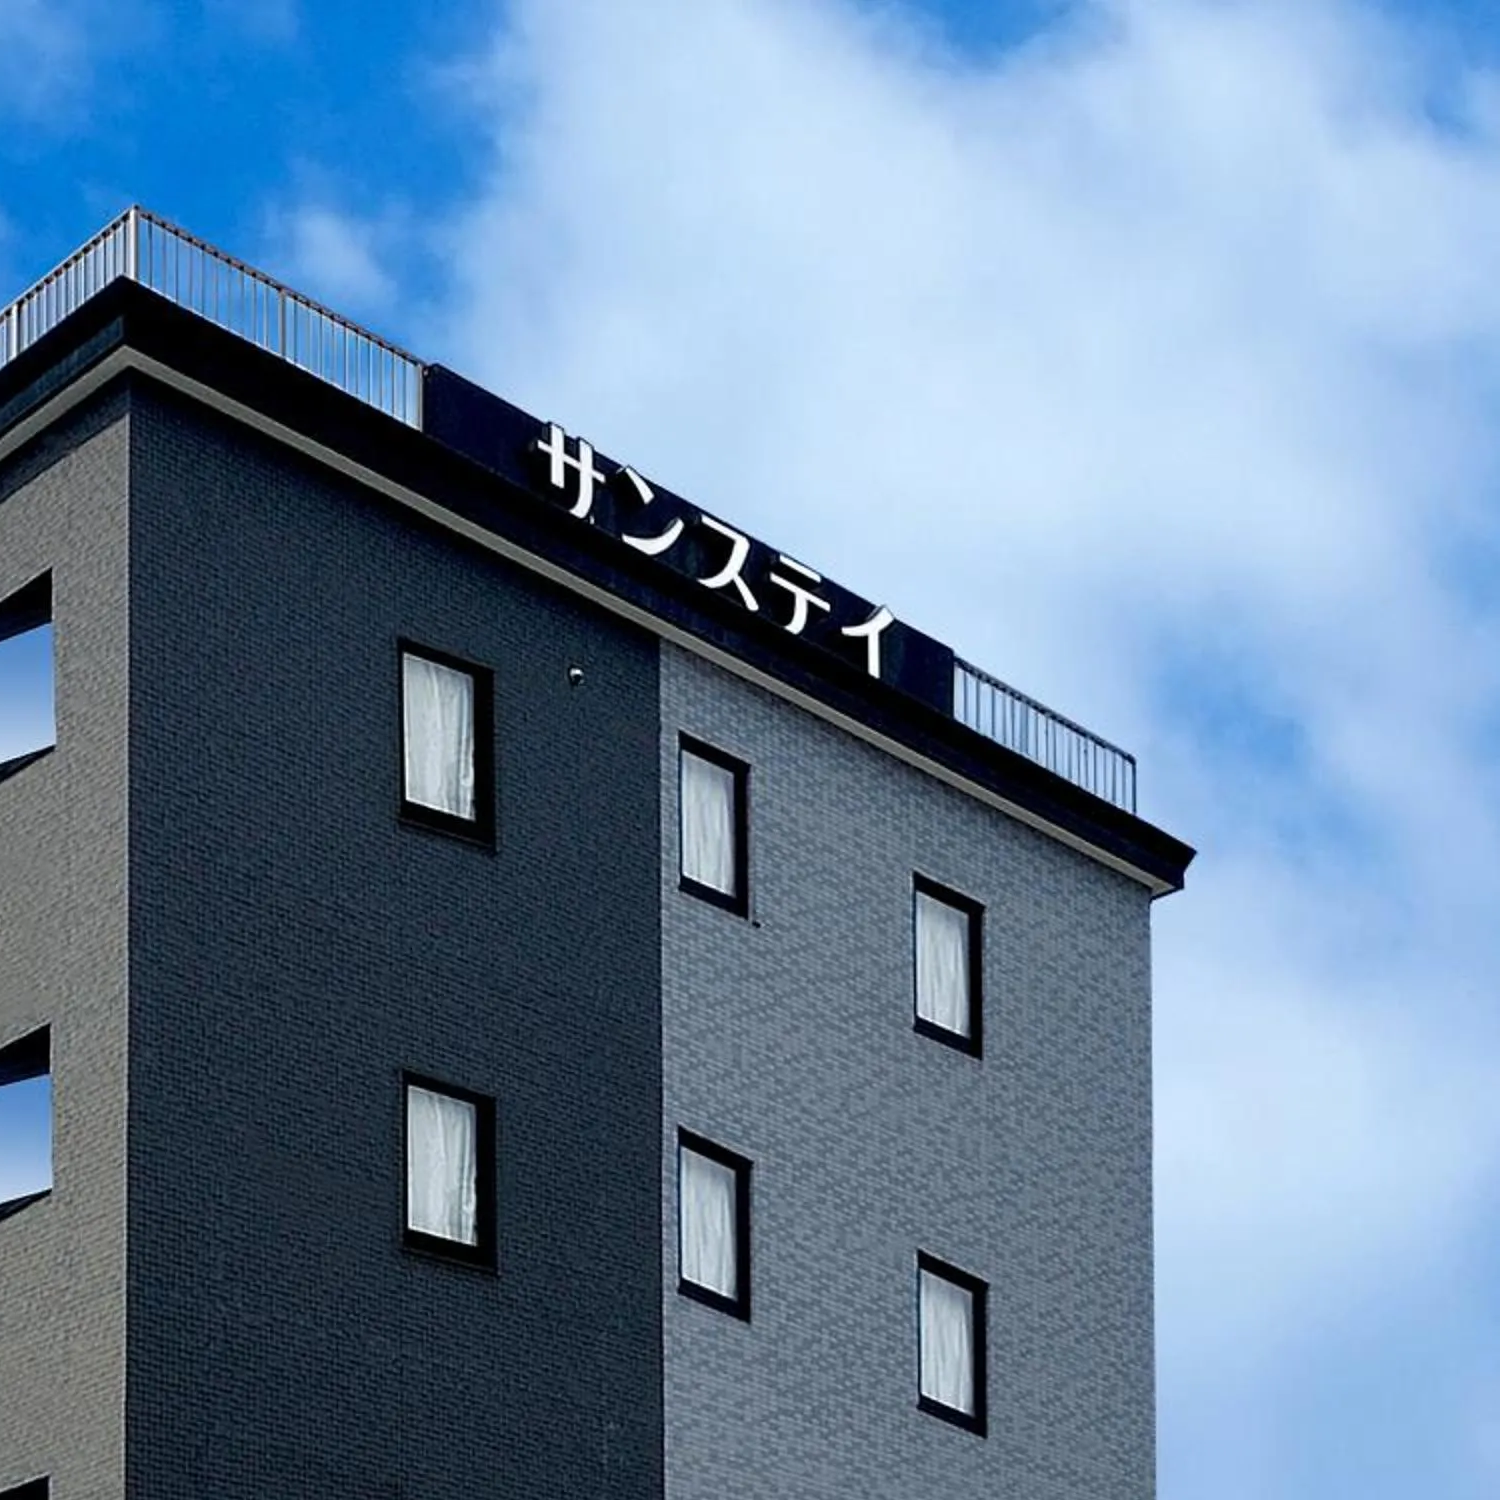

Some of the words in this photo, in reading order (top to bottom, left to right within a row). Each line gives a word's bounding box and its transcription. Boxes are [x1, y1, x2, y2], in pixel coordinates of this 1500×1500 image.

[537, 422, 895, 679] サンステイ
